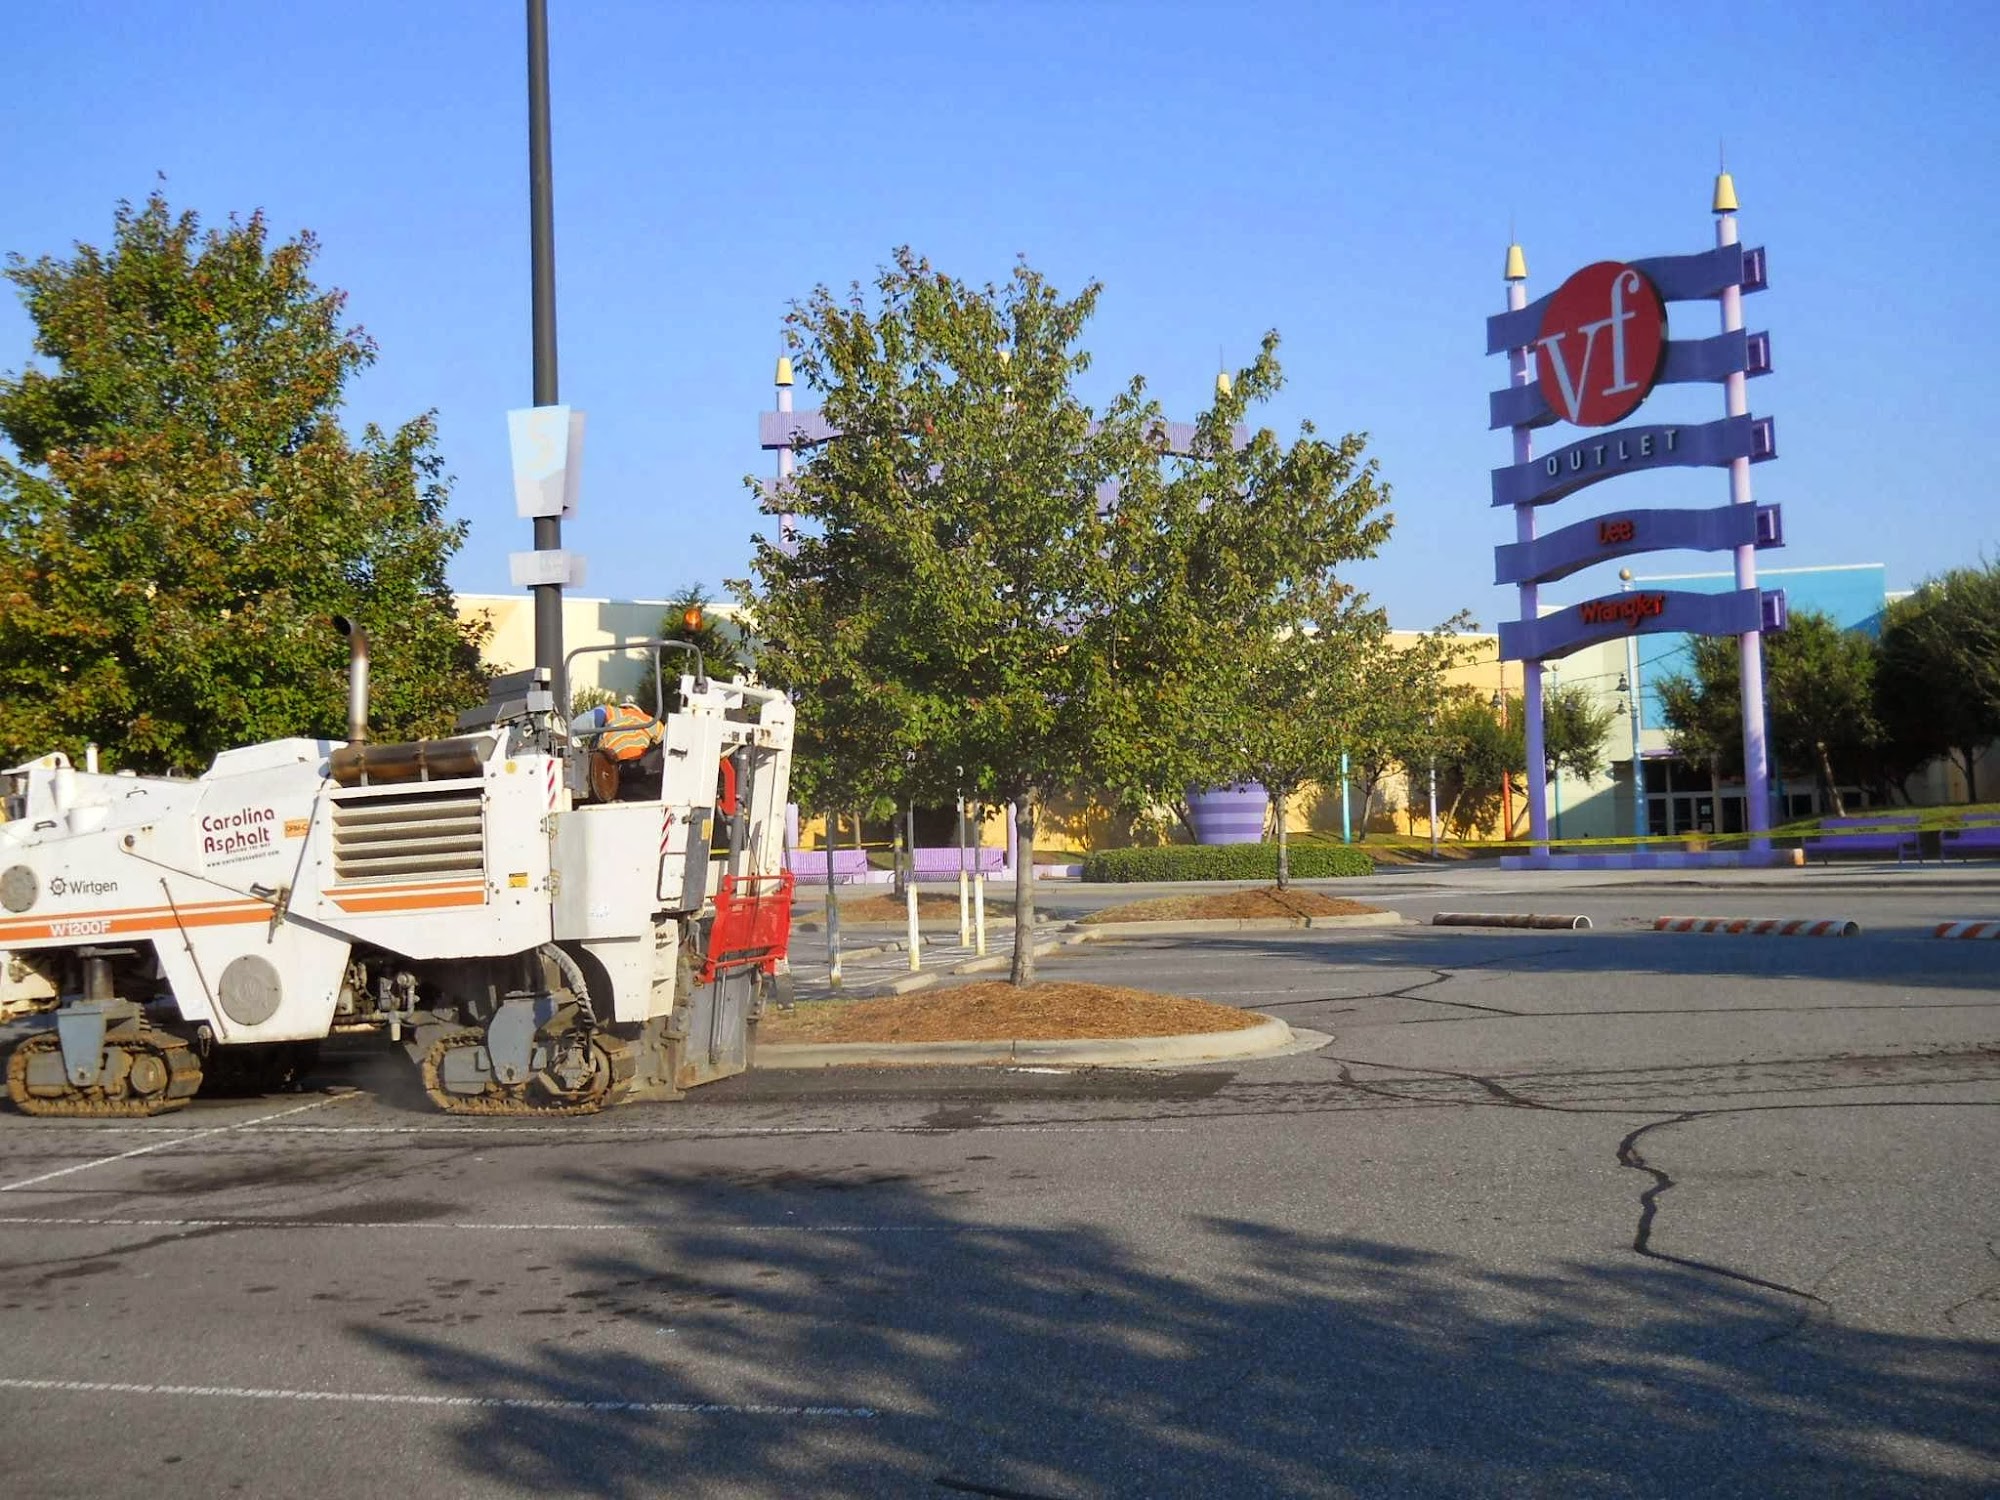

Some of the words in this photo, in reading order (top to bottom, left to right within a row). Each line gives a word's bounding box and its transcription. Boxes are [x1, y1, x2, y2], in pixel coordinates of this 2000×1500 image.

[1546, 429, 1677, 476] OUTLET
[1597, 520, 1635, 545] Lee
[1579, 593, 1665, 630] Wrangler
[202, 807, 275, 832] Carolina
[204, 826, 271, 854] Asphalt
[69, 880, 118, 896] Wirtgen
[50, 920, 112, 937] W1200F
